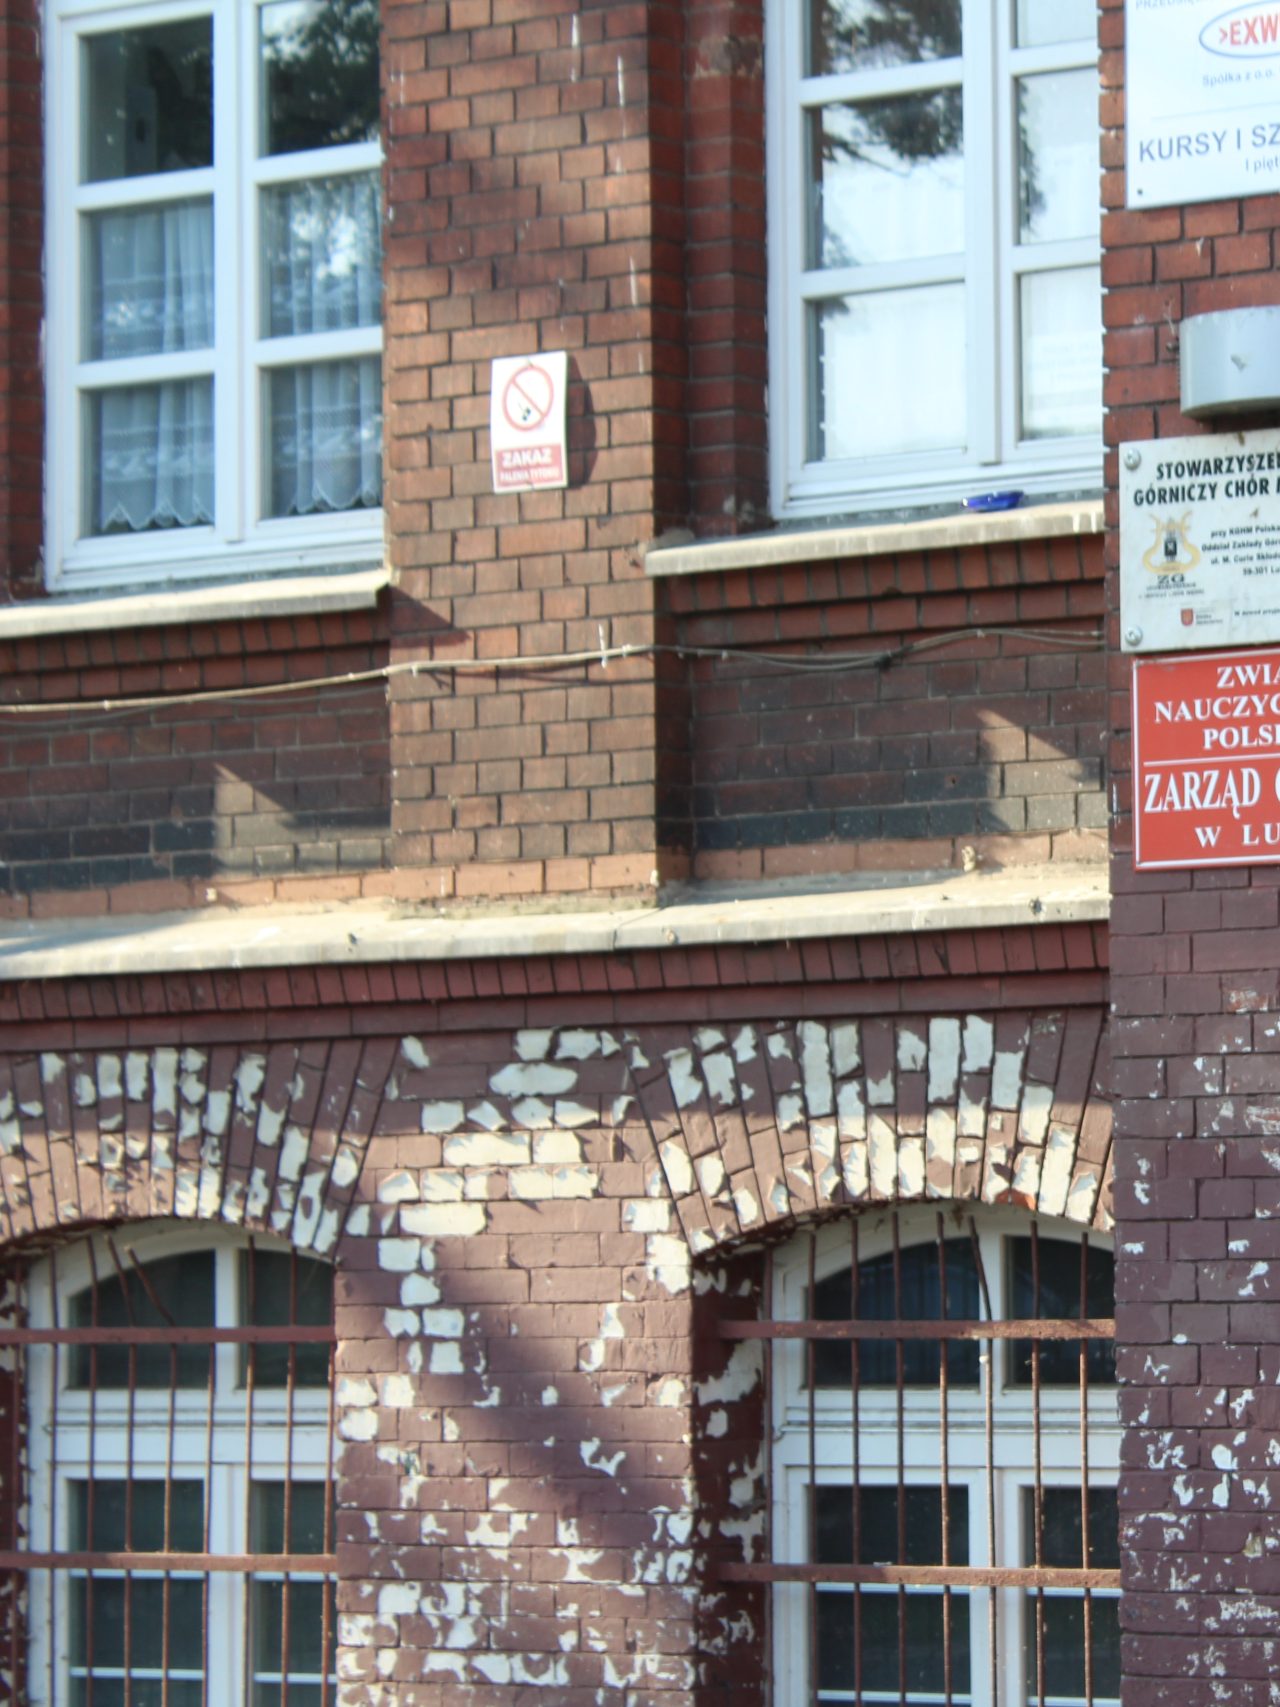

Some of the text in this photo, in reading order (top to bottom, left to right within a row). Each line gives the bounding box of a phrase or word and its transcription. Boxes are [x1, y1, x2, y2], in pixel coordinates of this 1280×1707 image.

[1202, 71, 1242, 87] Spółka
[1138, 130, 1228, 163] KURSY
[1235, 129, 1243, 151] I
[502, 447, 553, 470] ZAKAZ
[1133, 481, 1218, 506] GÓRNICZY
[1224, 474, 1270, 499] CHÓR
[1210, 530, 1227, 539] przy
[1255, 523, 1280, 533] Polska
[1201, 541, 1231, 552] Oddział
[1232, 539, 1263, 550] Zakłady
[1143, 766, 1262, 819] ZARZĄD
[1194, 825, 1222, 849] W
